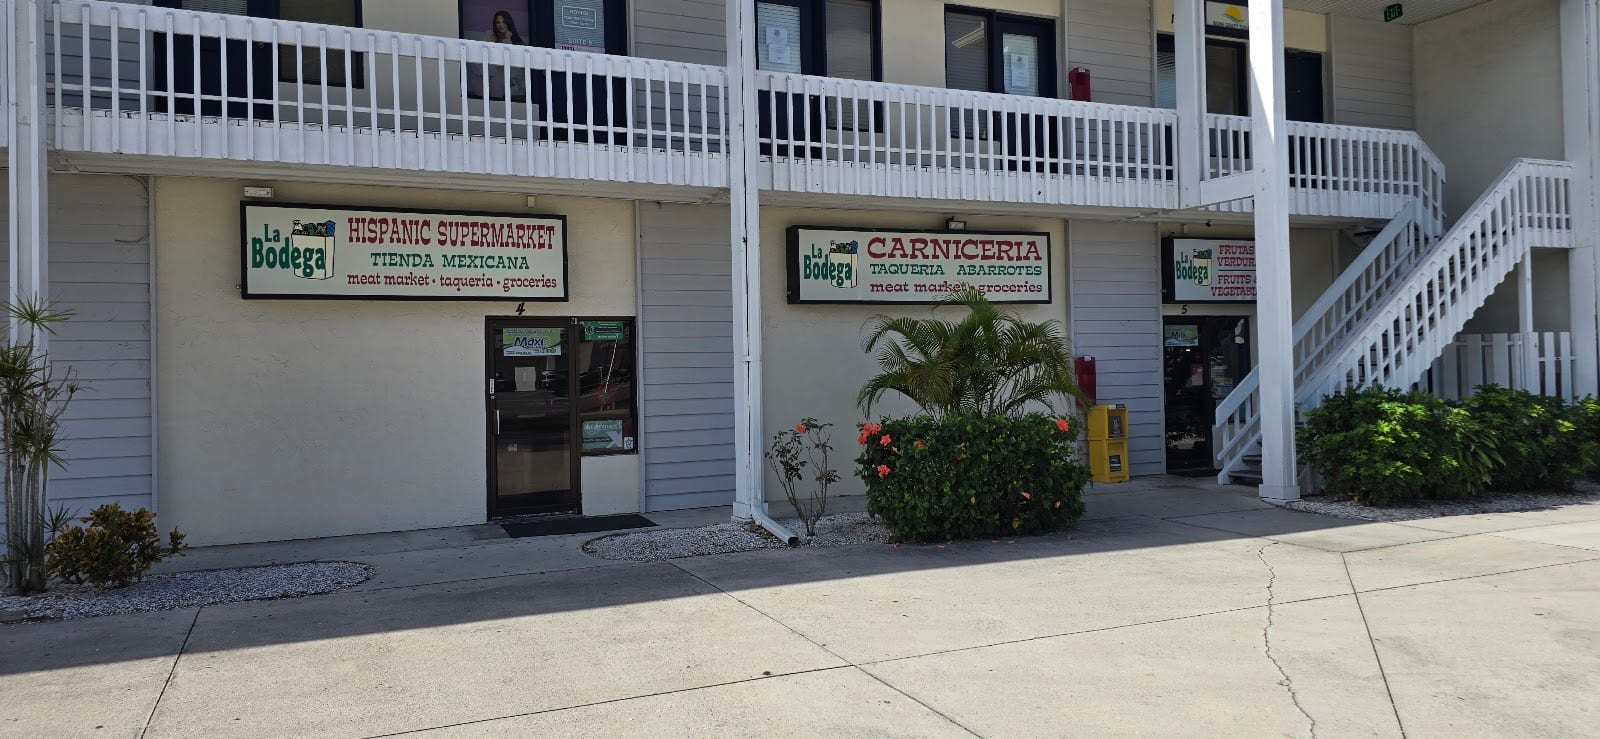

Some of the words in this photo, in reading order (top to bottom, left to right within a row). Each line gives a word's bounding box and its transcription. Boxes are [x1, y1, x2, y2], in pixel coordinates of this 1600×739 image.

[263, 223, 281, 243] La
[347, 217, 431, 246] HISPANIC
[437, 220, 555, 250] SUPERMARKET
[251, 236, 326, 278] Bodega
[811, 243, 823, 259] La
[867, 236, 1043, 262] CARNICERIA
[1218, 244, 1255, 256] FRUTAS
[370, 252, 435, 268] TIENDA
[441, 254, 530, 270] MEXICANA
[1180, 251, 1189, 264] La
[803, 253, 852, 287] Bodega
[869, 263, 945, 276] TAQUERIA
[956, 264, 1043, 276] ABARROTES
[1175, 259, 1209, 285] Bodega
[347, 272, 381, 286] meat
[384, 271, 430, 287] market
[440, 273, 494, 292] taqueria
[502, 274, 557, 292] groceries
[1217, 274, 1252, 285] FRUITS
[869, 281, 910, 293] meat
[914, 280, 966, 294] market
[978, 280, 1043, 296] groceries
[515, 302, 526, 315] 4
[1181, 304, 1188, 315] 5
[514, 336, 545, 348] Maxi
